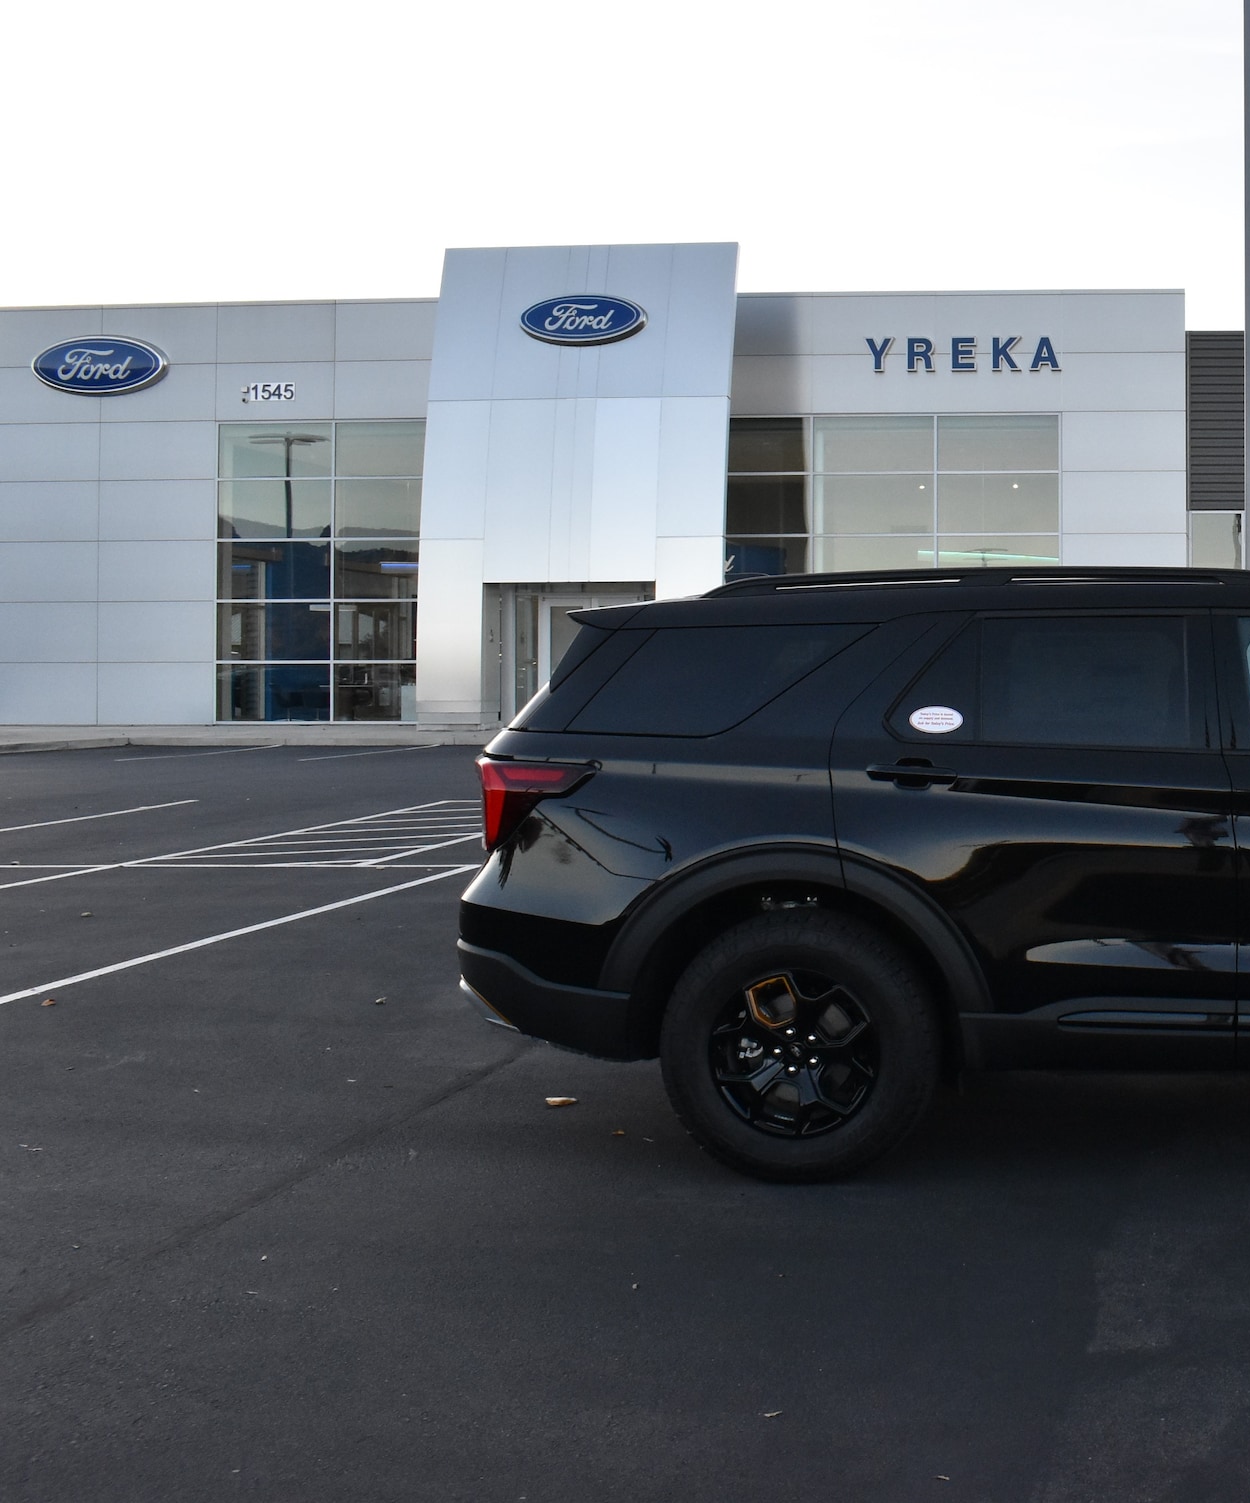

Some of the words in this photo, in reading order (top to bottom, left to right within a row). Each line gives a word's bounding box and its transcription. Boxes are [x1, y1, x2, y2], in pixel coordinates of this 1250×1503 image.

[544, 303, 615, 331] Ford
[57, 348, 132, 381] Ford
[865, 337, 1061, 373] YREKA
[251, 384, 294, 400] 1545
